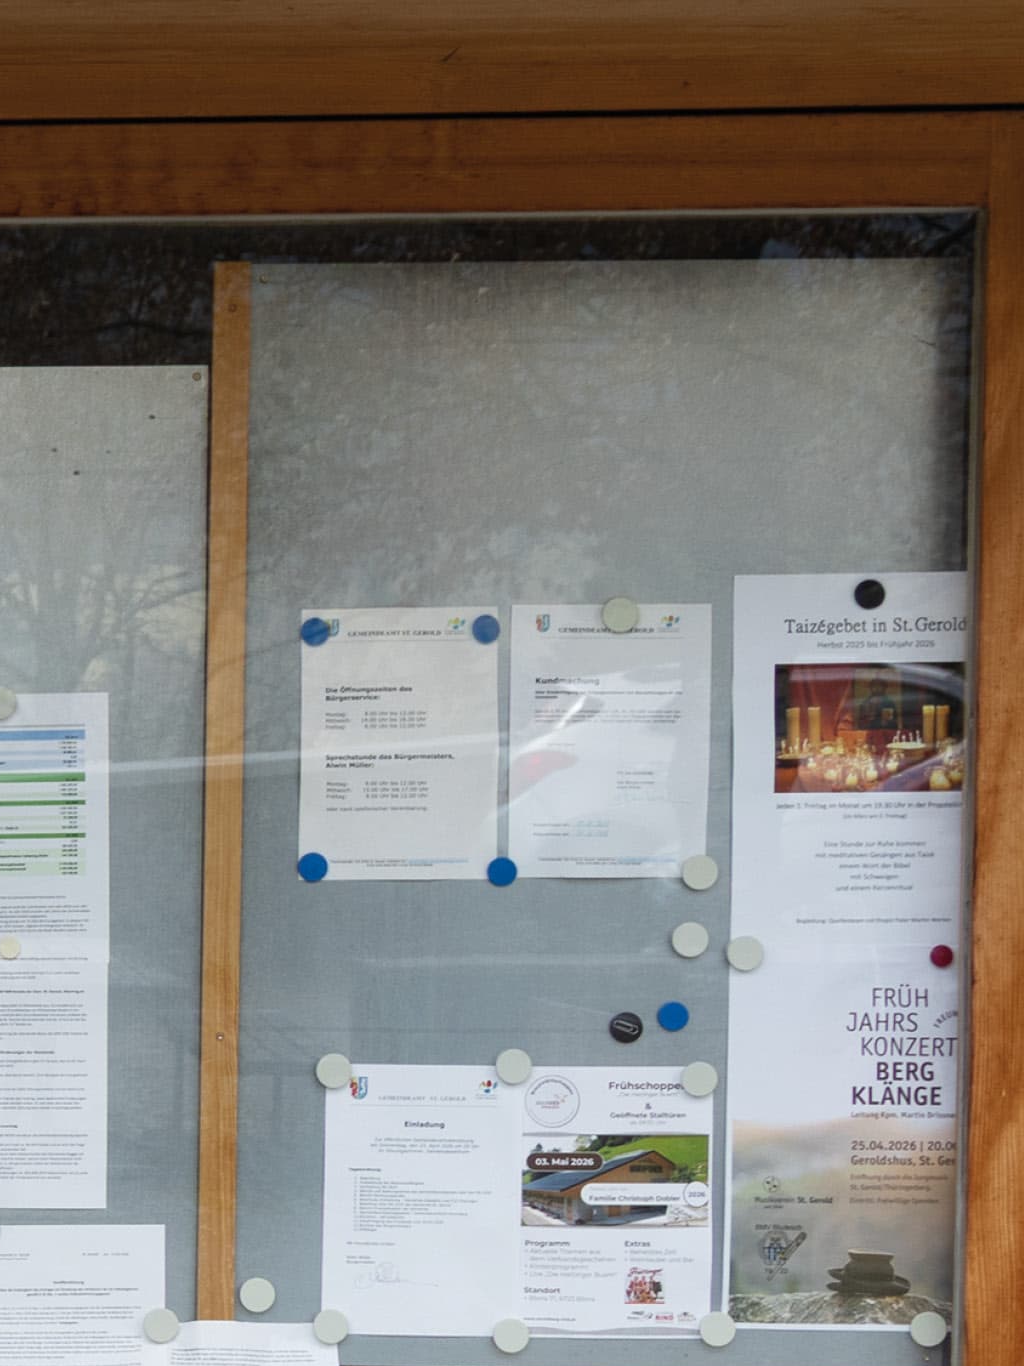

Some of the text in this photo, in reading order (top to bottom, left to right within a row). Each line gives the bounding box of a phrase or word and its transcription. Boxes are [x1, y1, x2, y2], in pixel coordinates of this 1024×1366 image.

[784, 616, 967, 636] Taizégebet in St. Gerold
[872, 984, 928, 1008] FRÜH
[846, 1012, 918, 1032] JAHRS
[861, 1036, 958, 1057] KONZERT
[876, 1061, 934, 1081] BERG
[852, 1081, 942, 1106] KLÄNGE
[404, 1121, 445, 1129] Einladung
[851, 1140, 917, 1151] 25.04.2026
[535, 1157, 594, 1166] 03. Mai 2026
[851, 1155, 916, 1167] Geroldshus,
[919, 1155, 935, 1166] St.
[525, 1240, 570, 1248] Programm
[524, 1286, 560, 1294] Standort
